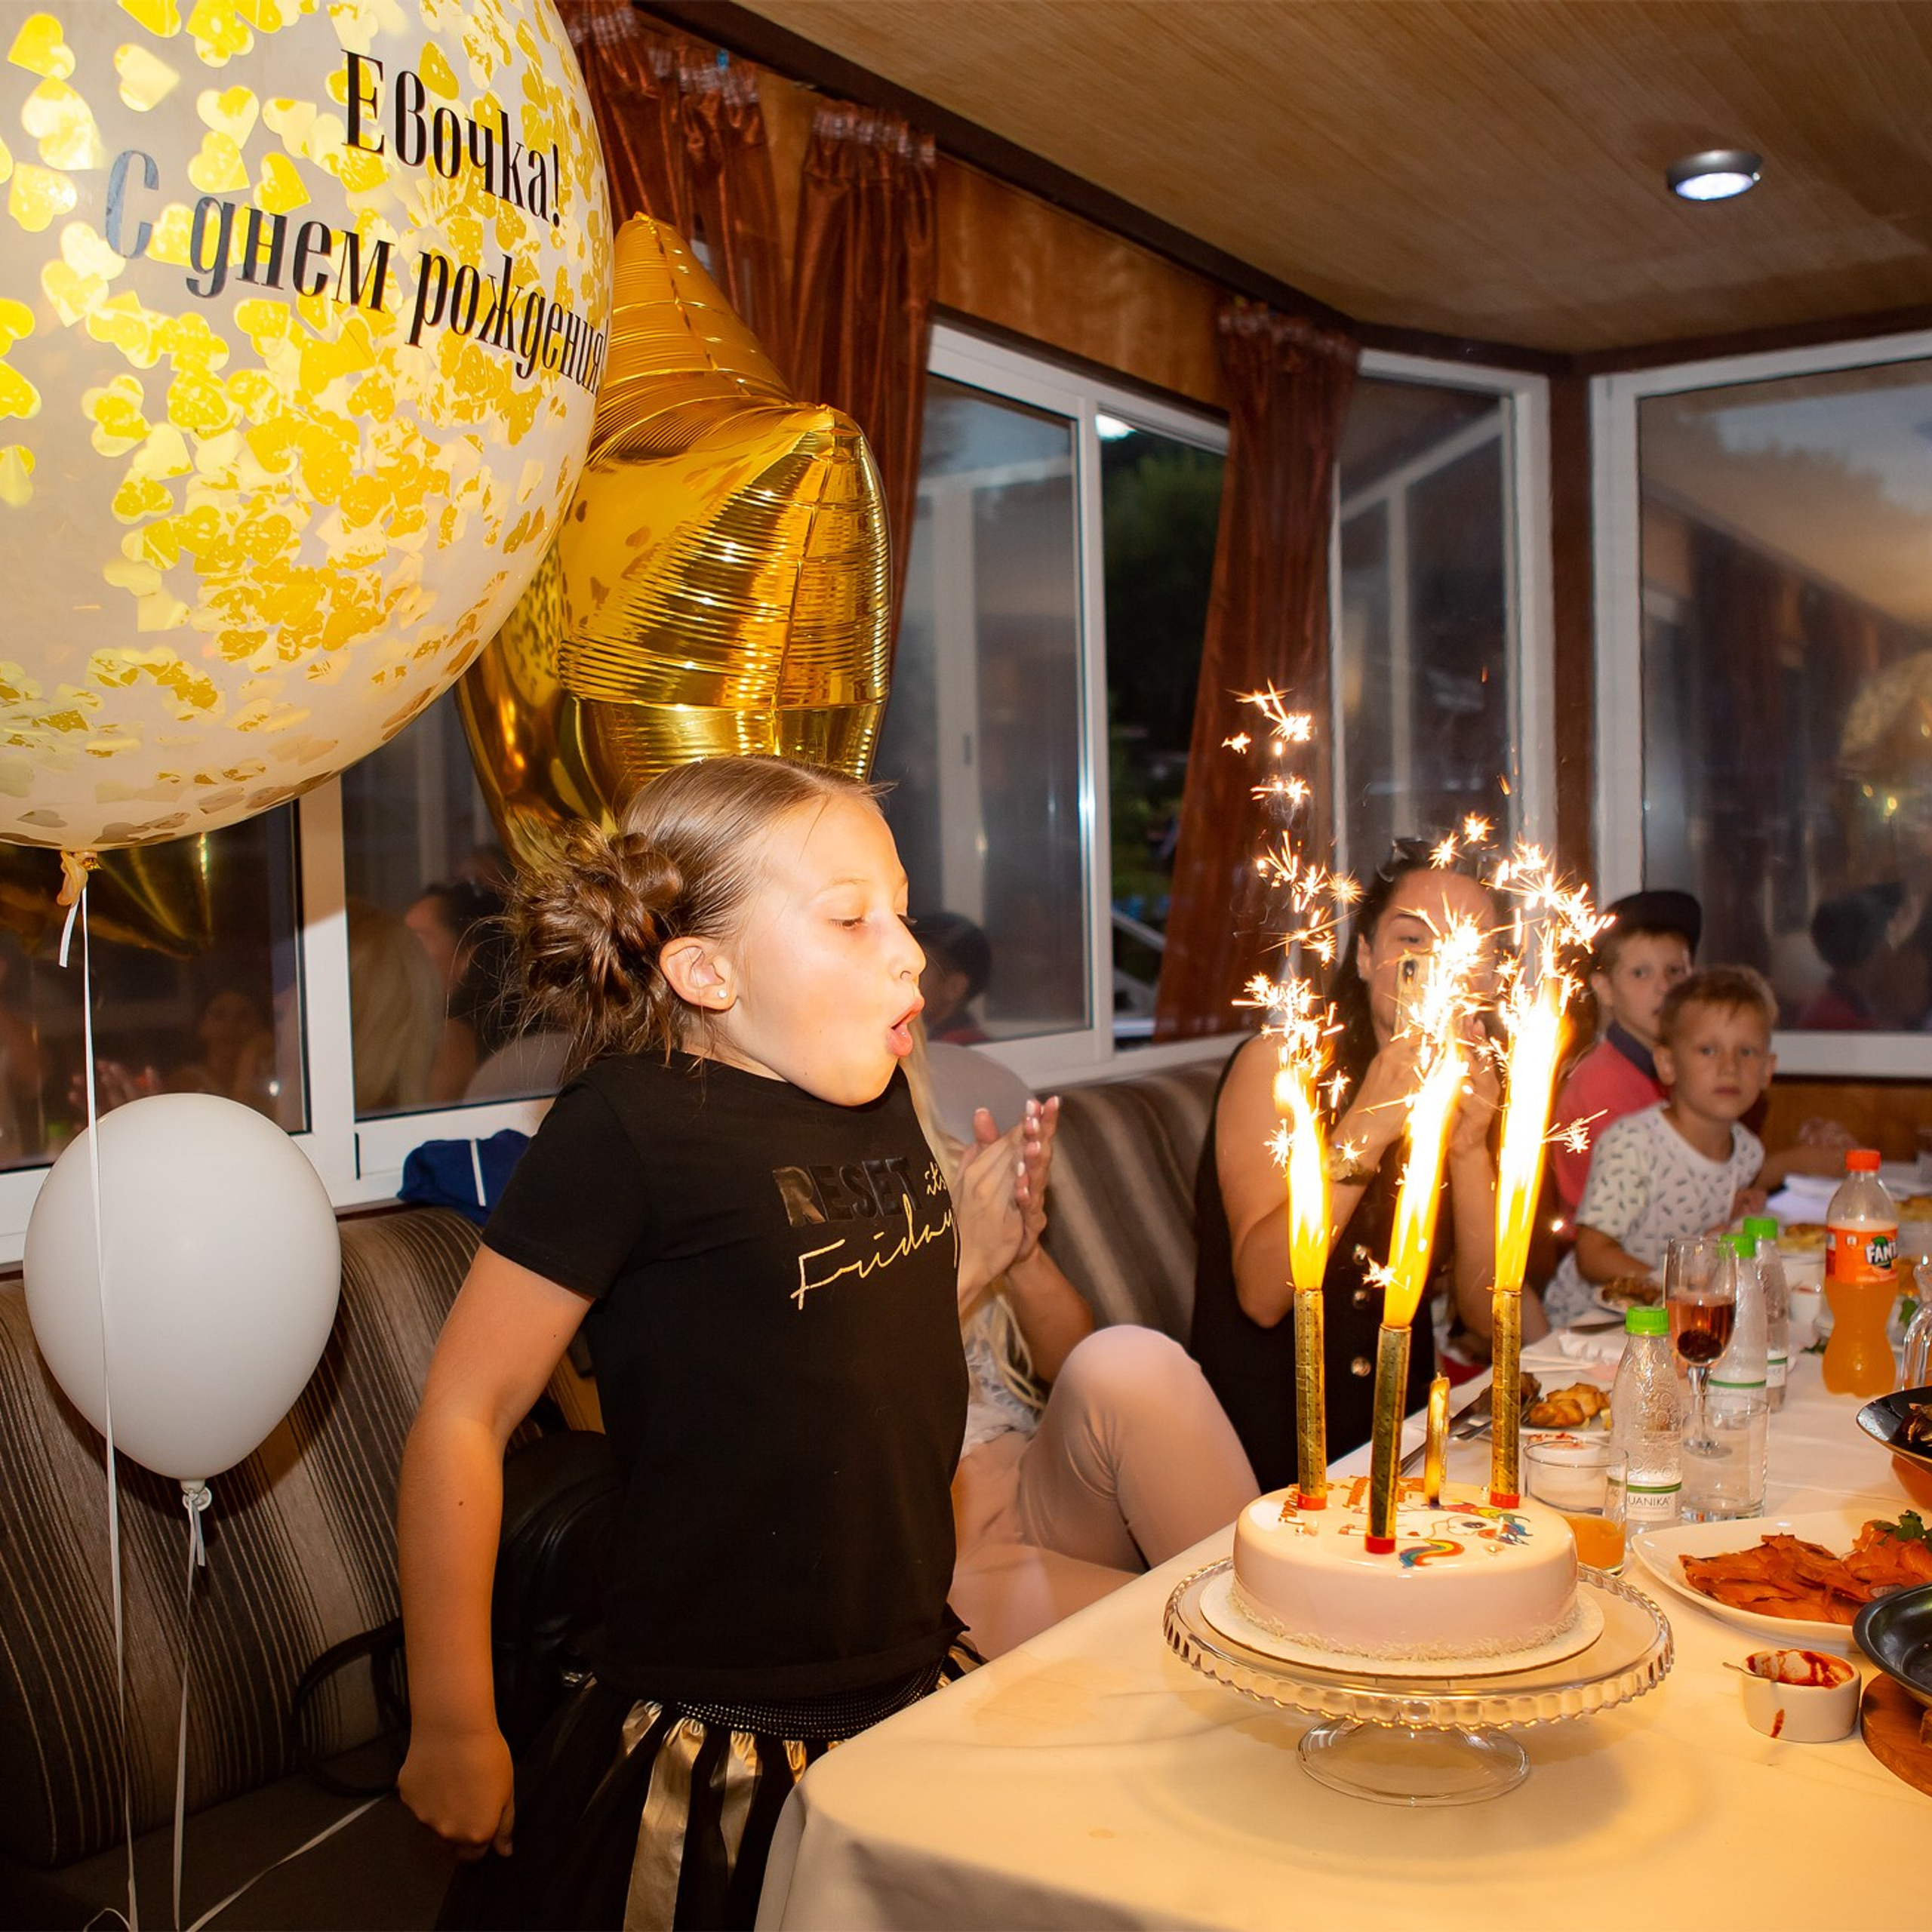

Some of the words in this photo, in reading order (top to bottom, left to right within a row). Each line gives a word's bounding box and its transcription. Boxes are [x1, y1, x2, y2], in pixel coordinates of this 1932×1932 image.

[340, 48, 560, 228] Евочка!
[106, 150, 159, 260] С
[771, 1157, 922, 1227] RESET
[790, 1193, 958, 1310] Friday
